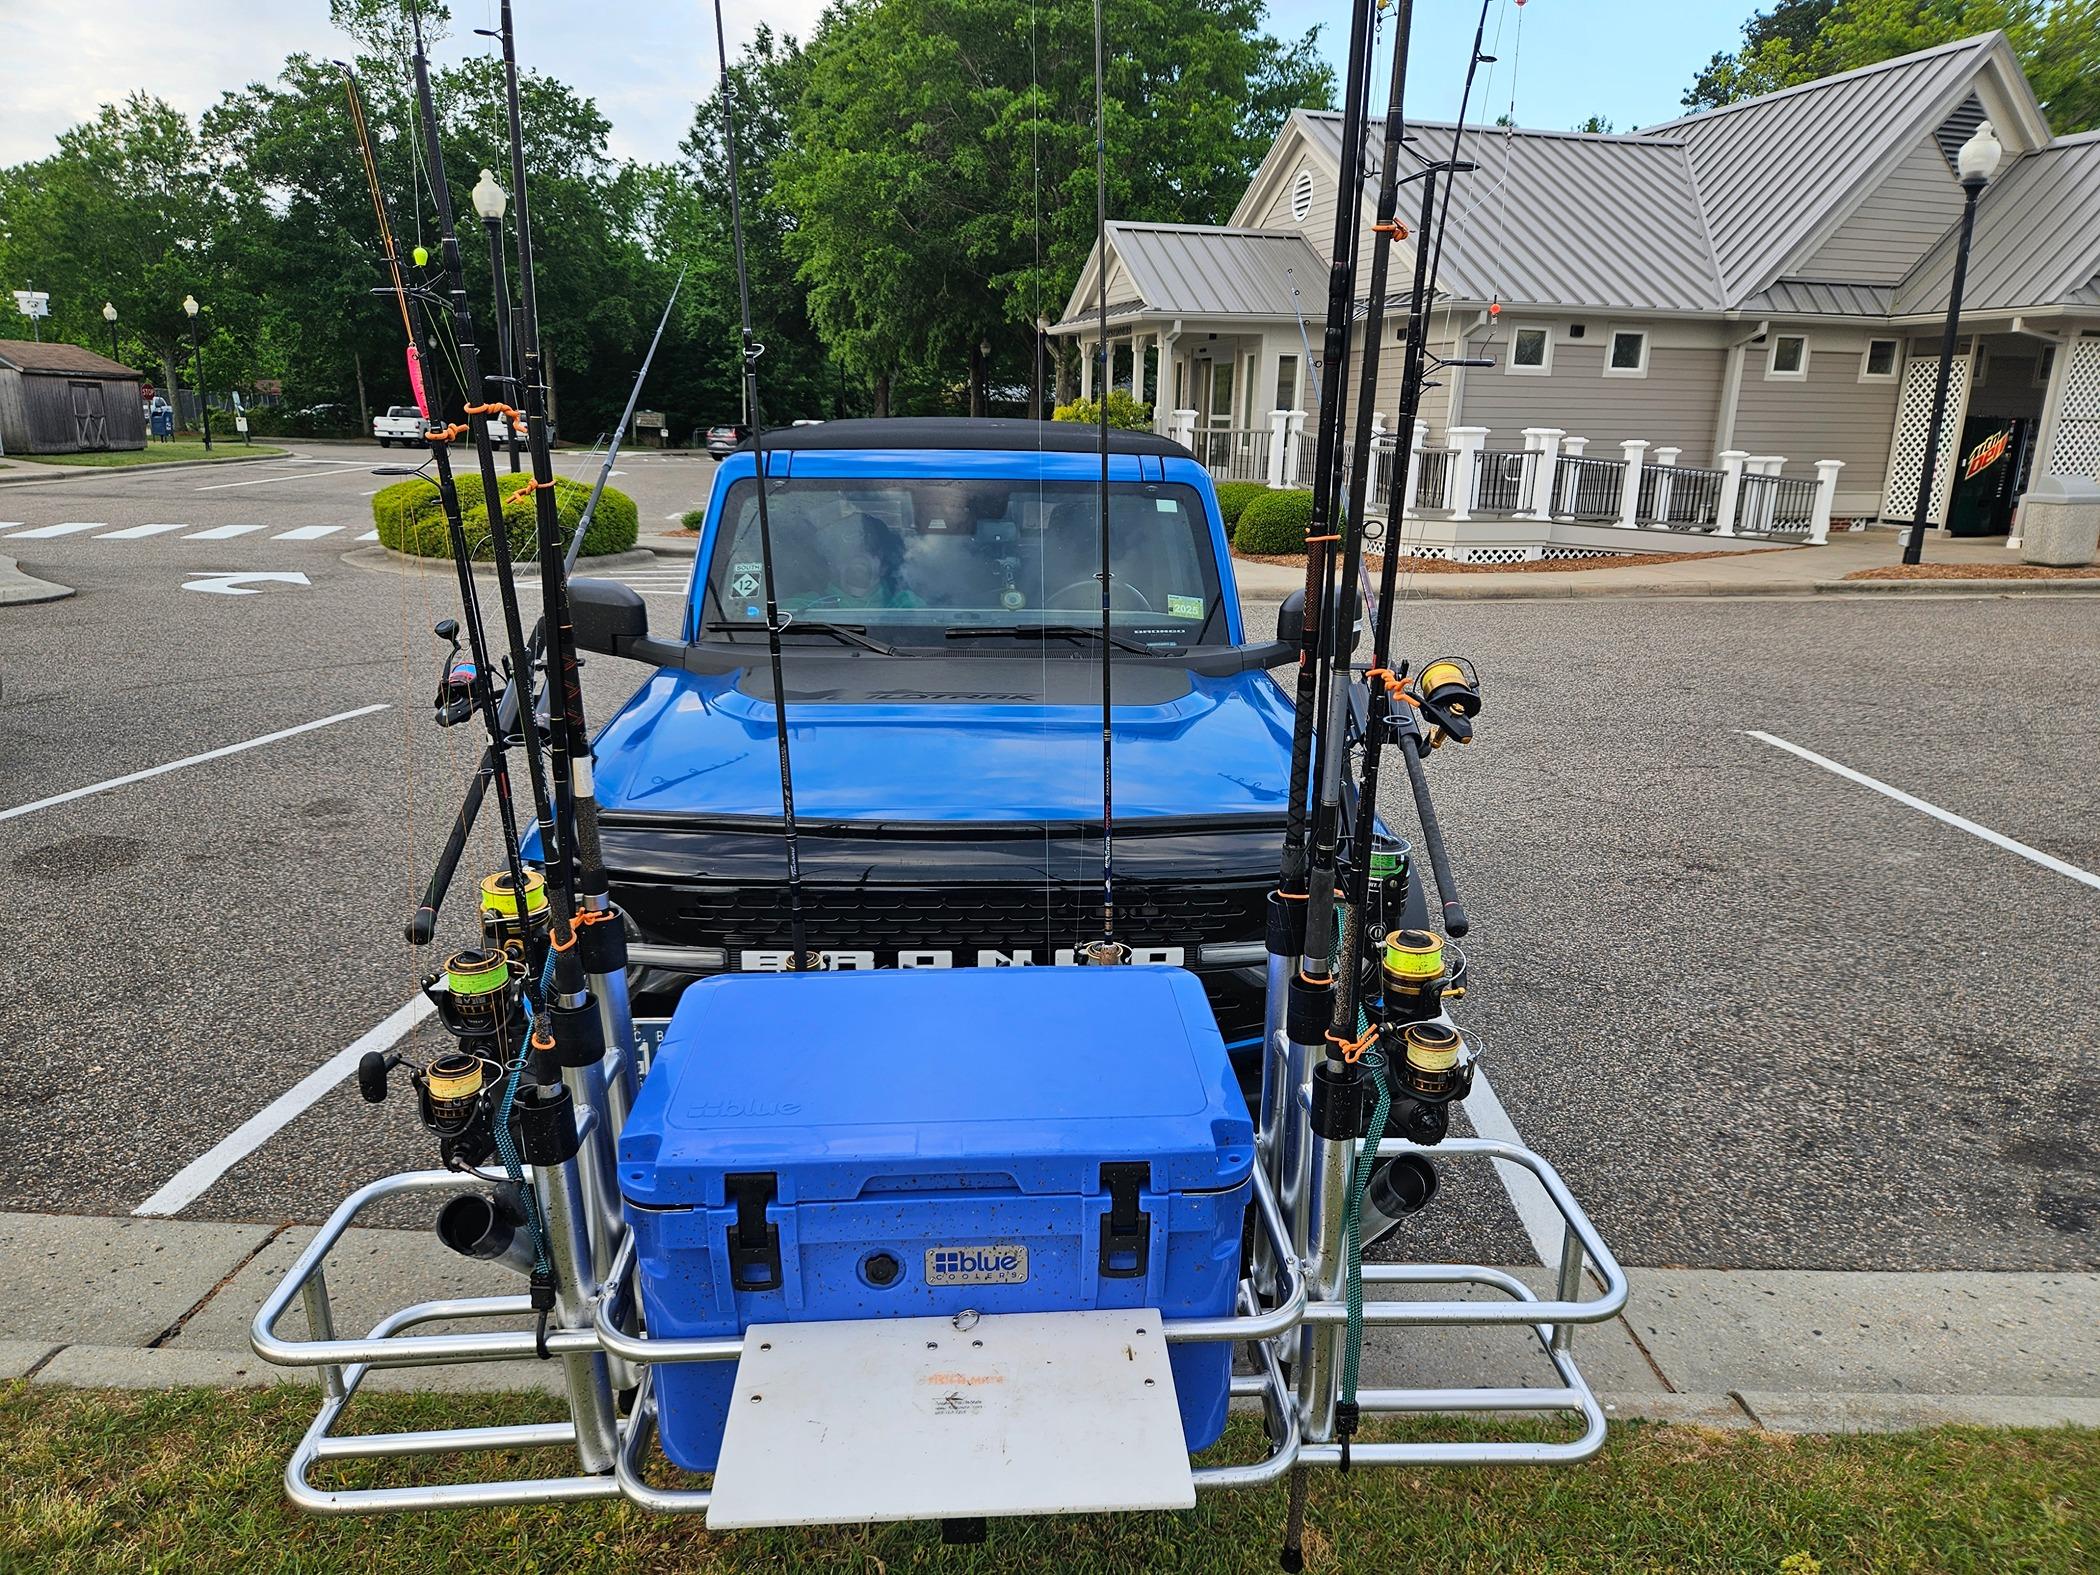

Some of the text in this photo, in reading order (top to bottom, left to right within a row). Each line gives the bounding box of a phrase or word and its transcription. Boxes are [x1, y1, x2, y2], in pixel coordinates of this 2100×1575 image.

[142, 388, 154, 396] STOP
[739, 580, 752, 591] 12
[1174, 604, 1198, 615] 2025
[724, 1097, 801, 1117] blue
[960, 1251, 1018, 1272] blue
[936, 1272, 1017, 1281] COOLERS
